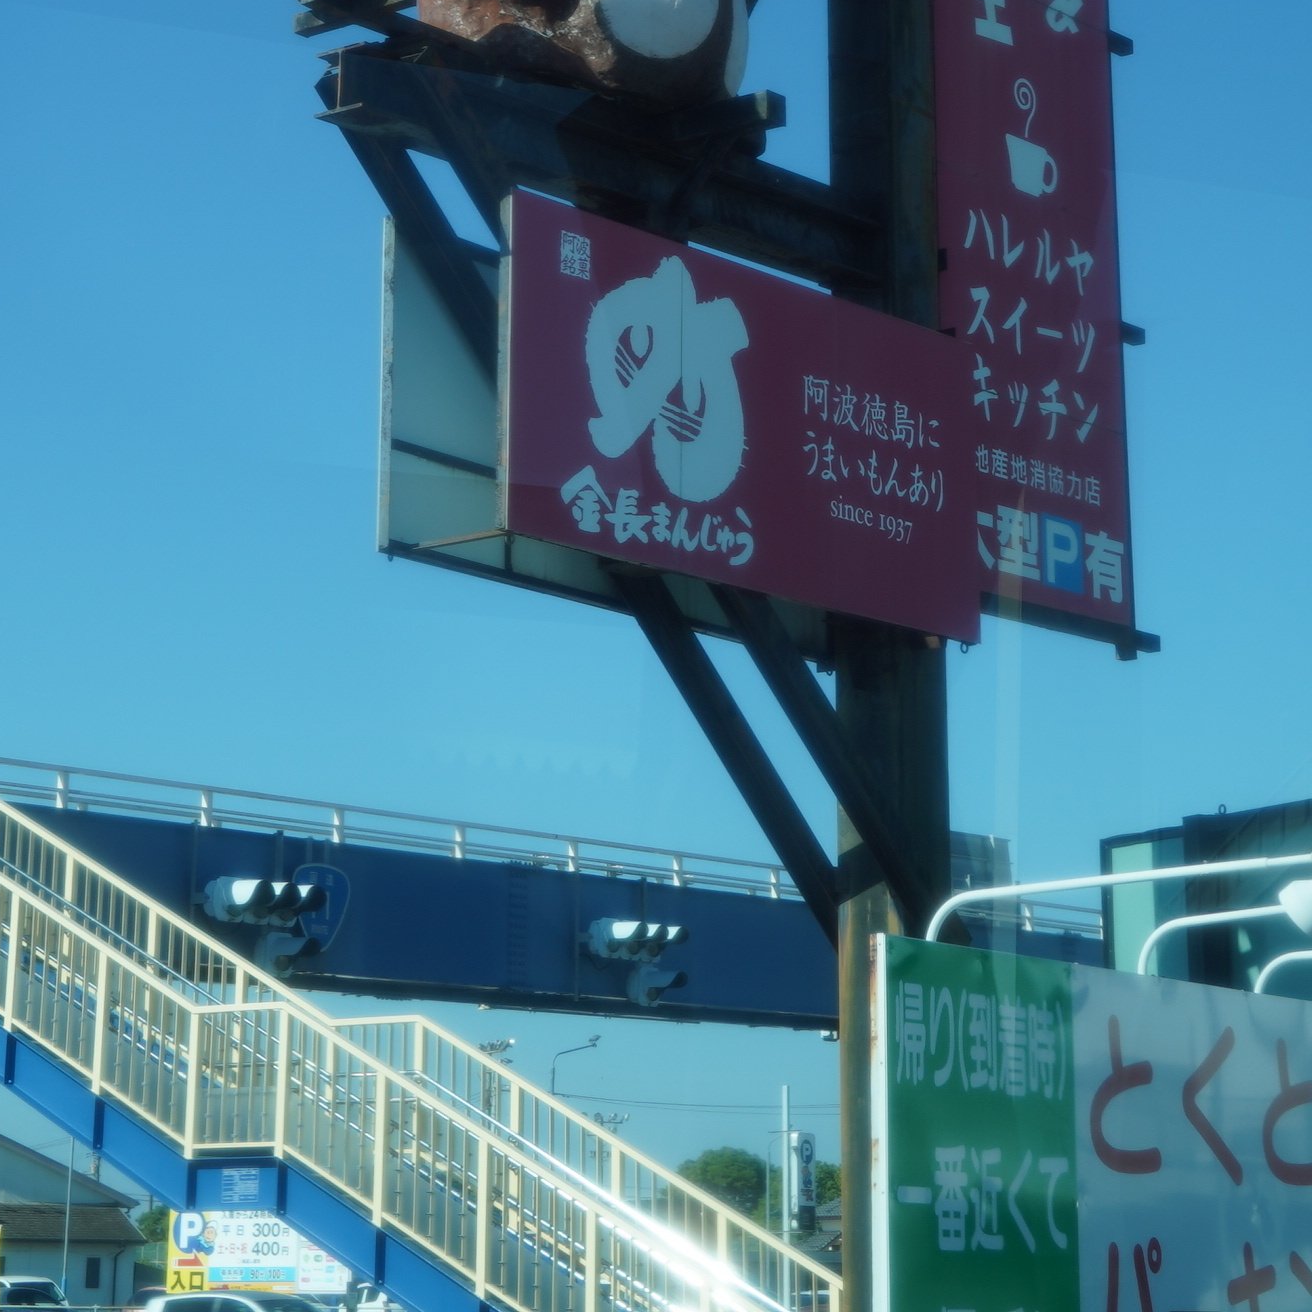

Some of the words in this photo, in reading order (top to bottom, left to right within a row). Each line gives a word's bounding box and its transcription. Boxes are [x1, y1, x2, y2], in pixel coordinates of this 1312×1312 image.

[964, 208, 1094, 297] ハレルヤ
[967, 286, 1096, 374] スイーツ
[803, 374, 941, 449] 阿波徳島に
[972, 352, 1099, 444] キッチン
[560, 465, 754, 566] 金長まんじゅう
[803, 430, 944, 513] うまいもんあり
[830, 495, 873, 527] since
[879, 513, 913, 545] 1937
[895, 979, 1067, 1101] 帰り(到着時)
[180, 1213, 203, 1249] P
[897, 1145, 1069, 1254] 一番近くて
[171, 1271, 204, 1291] 入口
